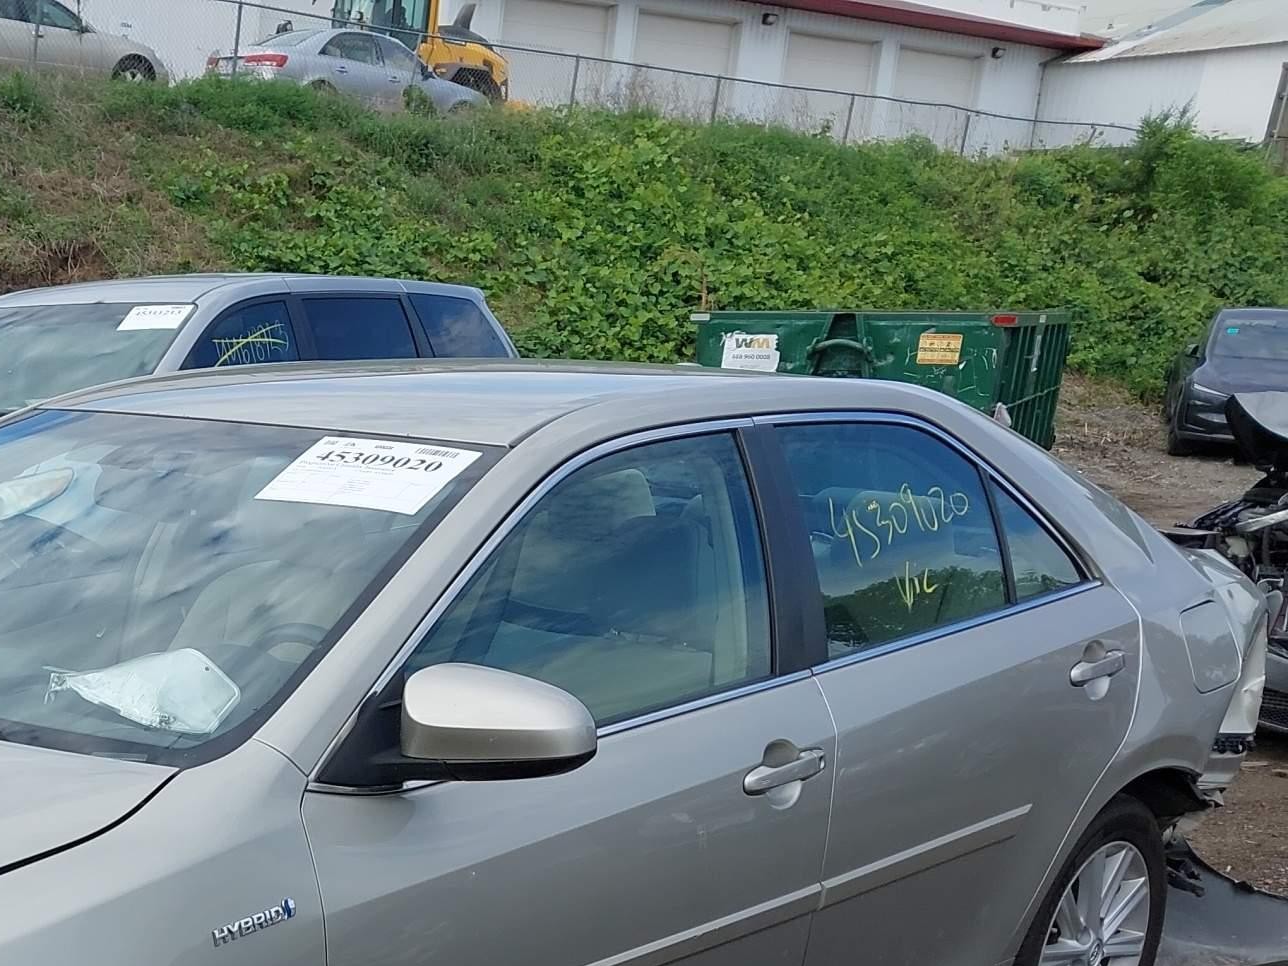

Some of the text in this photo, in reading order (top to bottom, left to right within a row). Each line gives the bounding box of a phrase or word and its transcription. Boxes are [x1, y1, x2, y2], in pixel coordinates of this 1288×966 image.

[735, 337, 770, 348] WM
[315, 450, 443, 473] 45309020
[829, 483, 969, 567] 45309020
[212, 905, 283, 947] HYBRID
